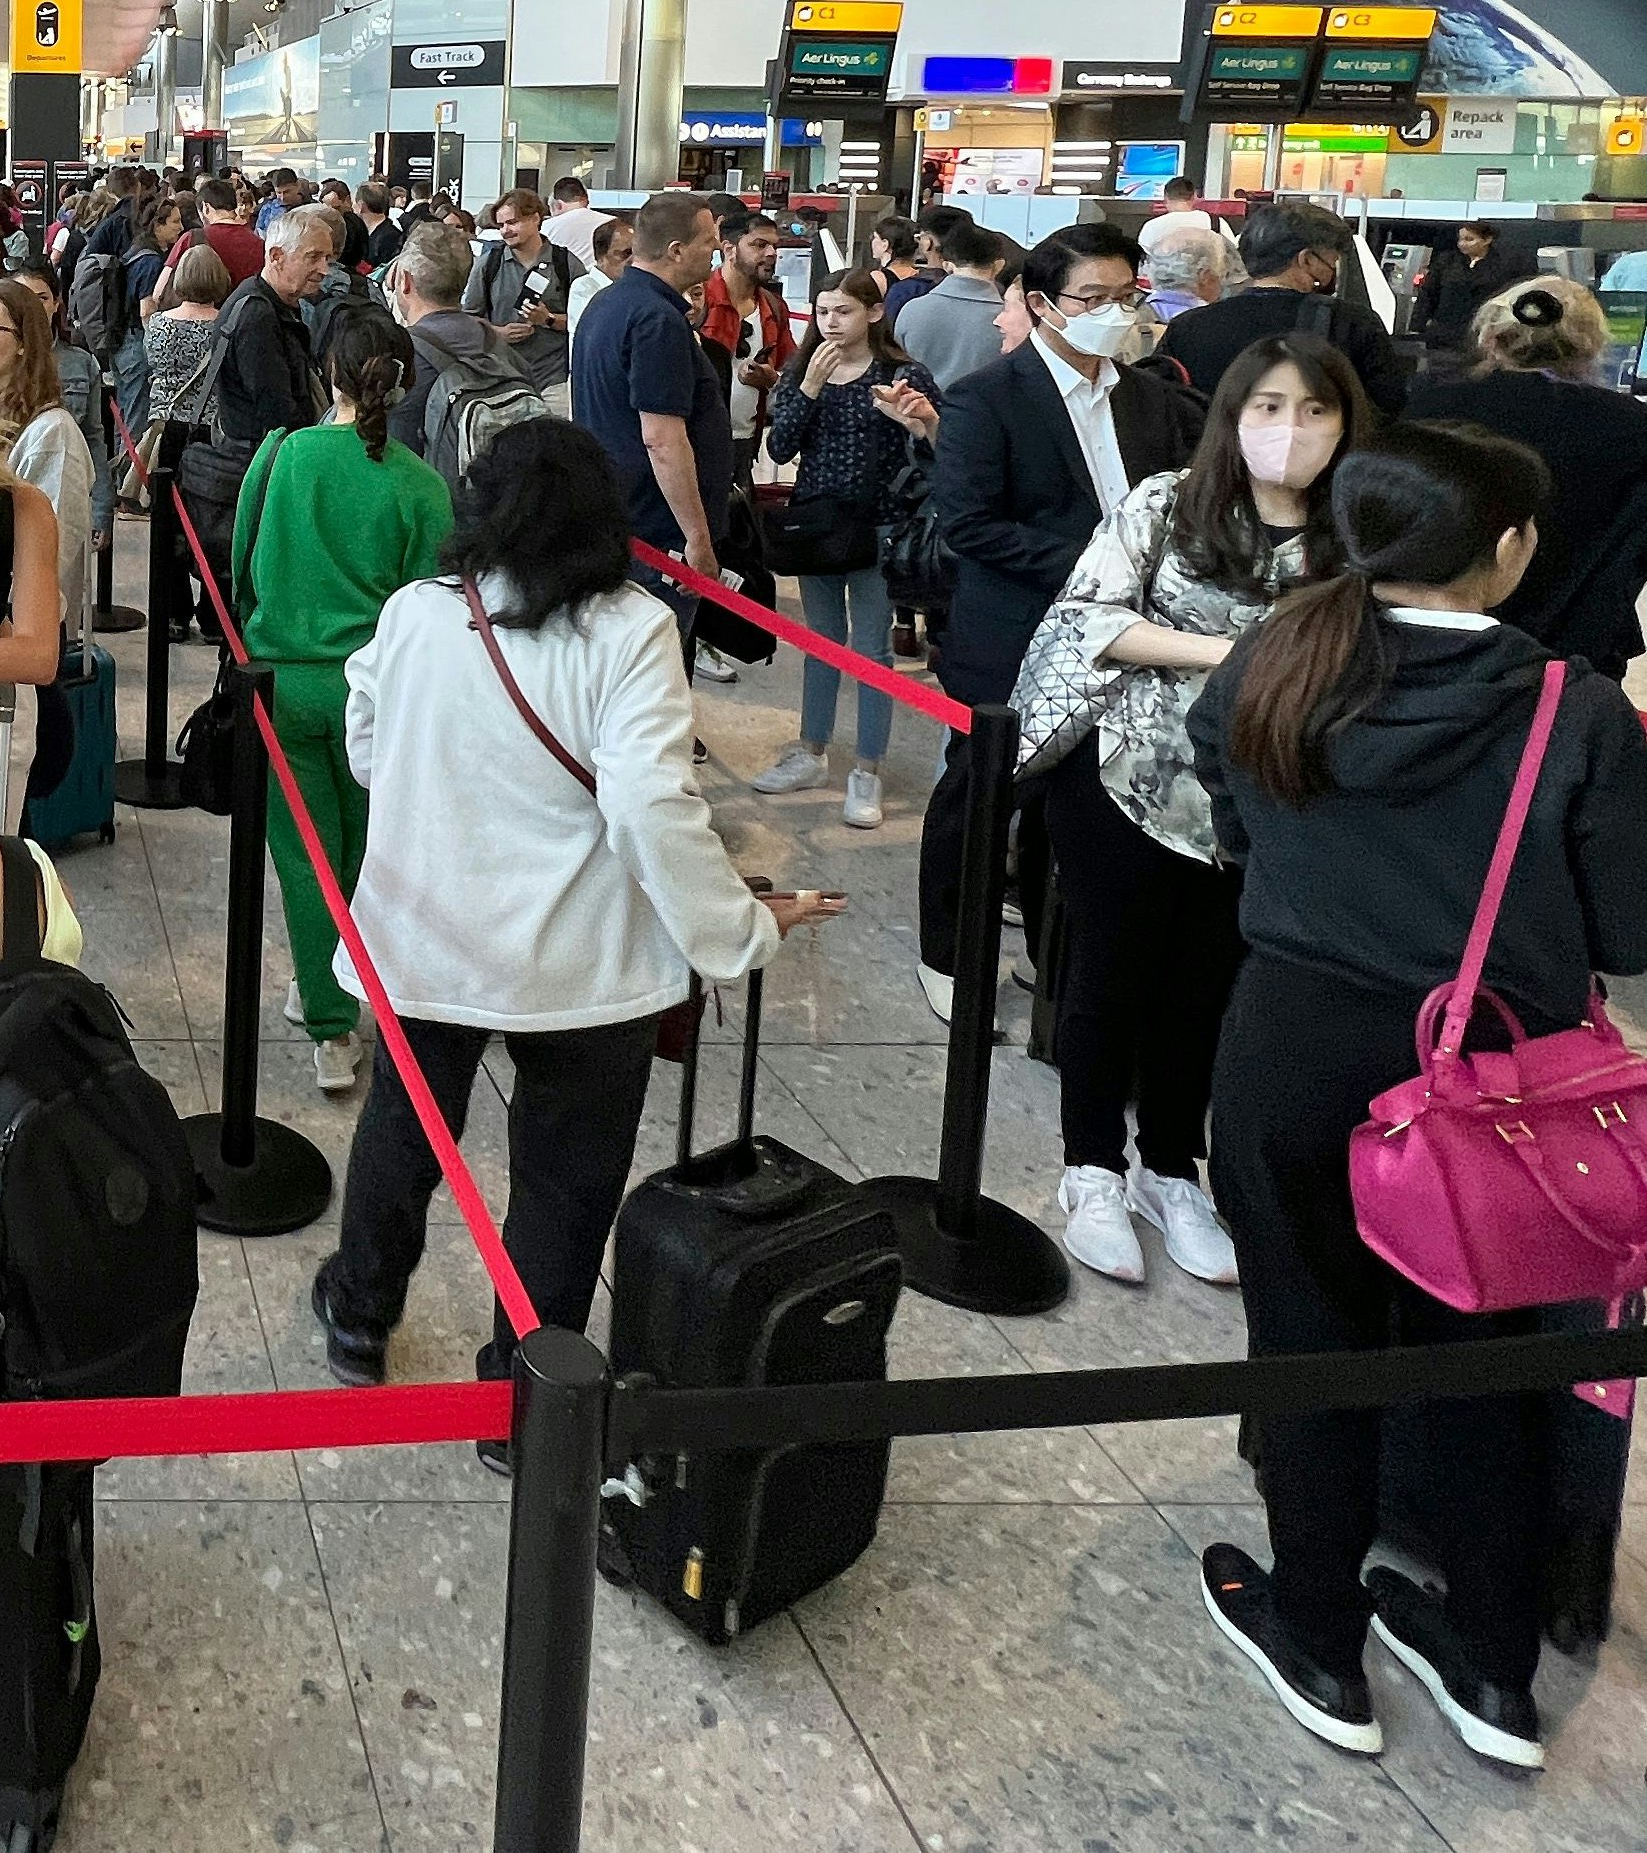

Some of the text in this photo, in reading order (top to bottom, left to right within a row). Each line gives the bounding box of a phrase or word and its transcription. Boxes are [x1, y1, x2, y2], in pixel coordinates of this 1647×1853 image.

[819, 7, 835, 19] C1
[1240, 12, 1257, 24] C2
[1354, 14, 1371, 26] C3
[419, 50, 474, 64] Fast Track
[801, 51, 861, 68] Aer Lingus
[1221, 57, 1279, 72] Aer Lingus
[1333, 58, 1392, 74] Aer Lingus
[1452, 110, 1504, 124] Repack
[1451, 130, 1482, 139] area
